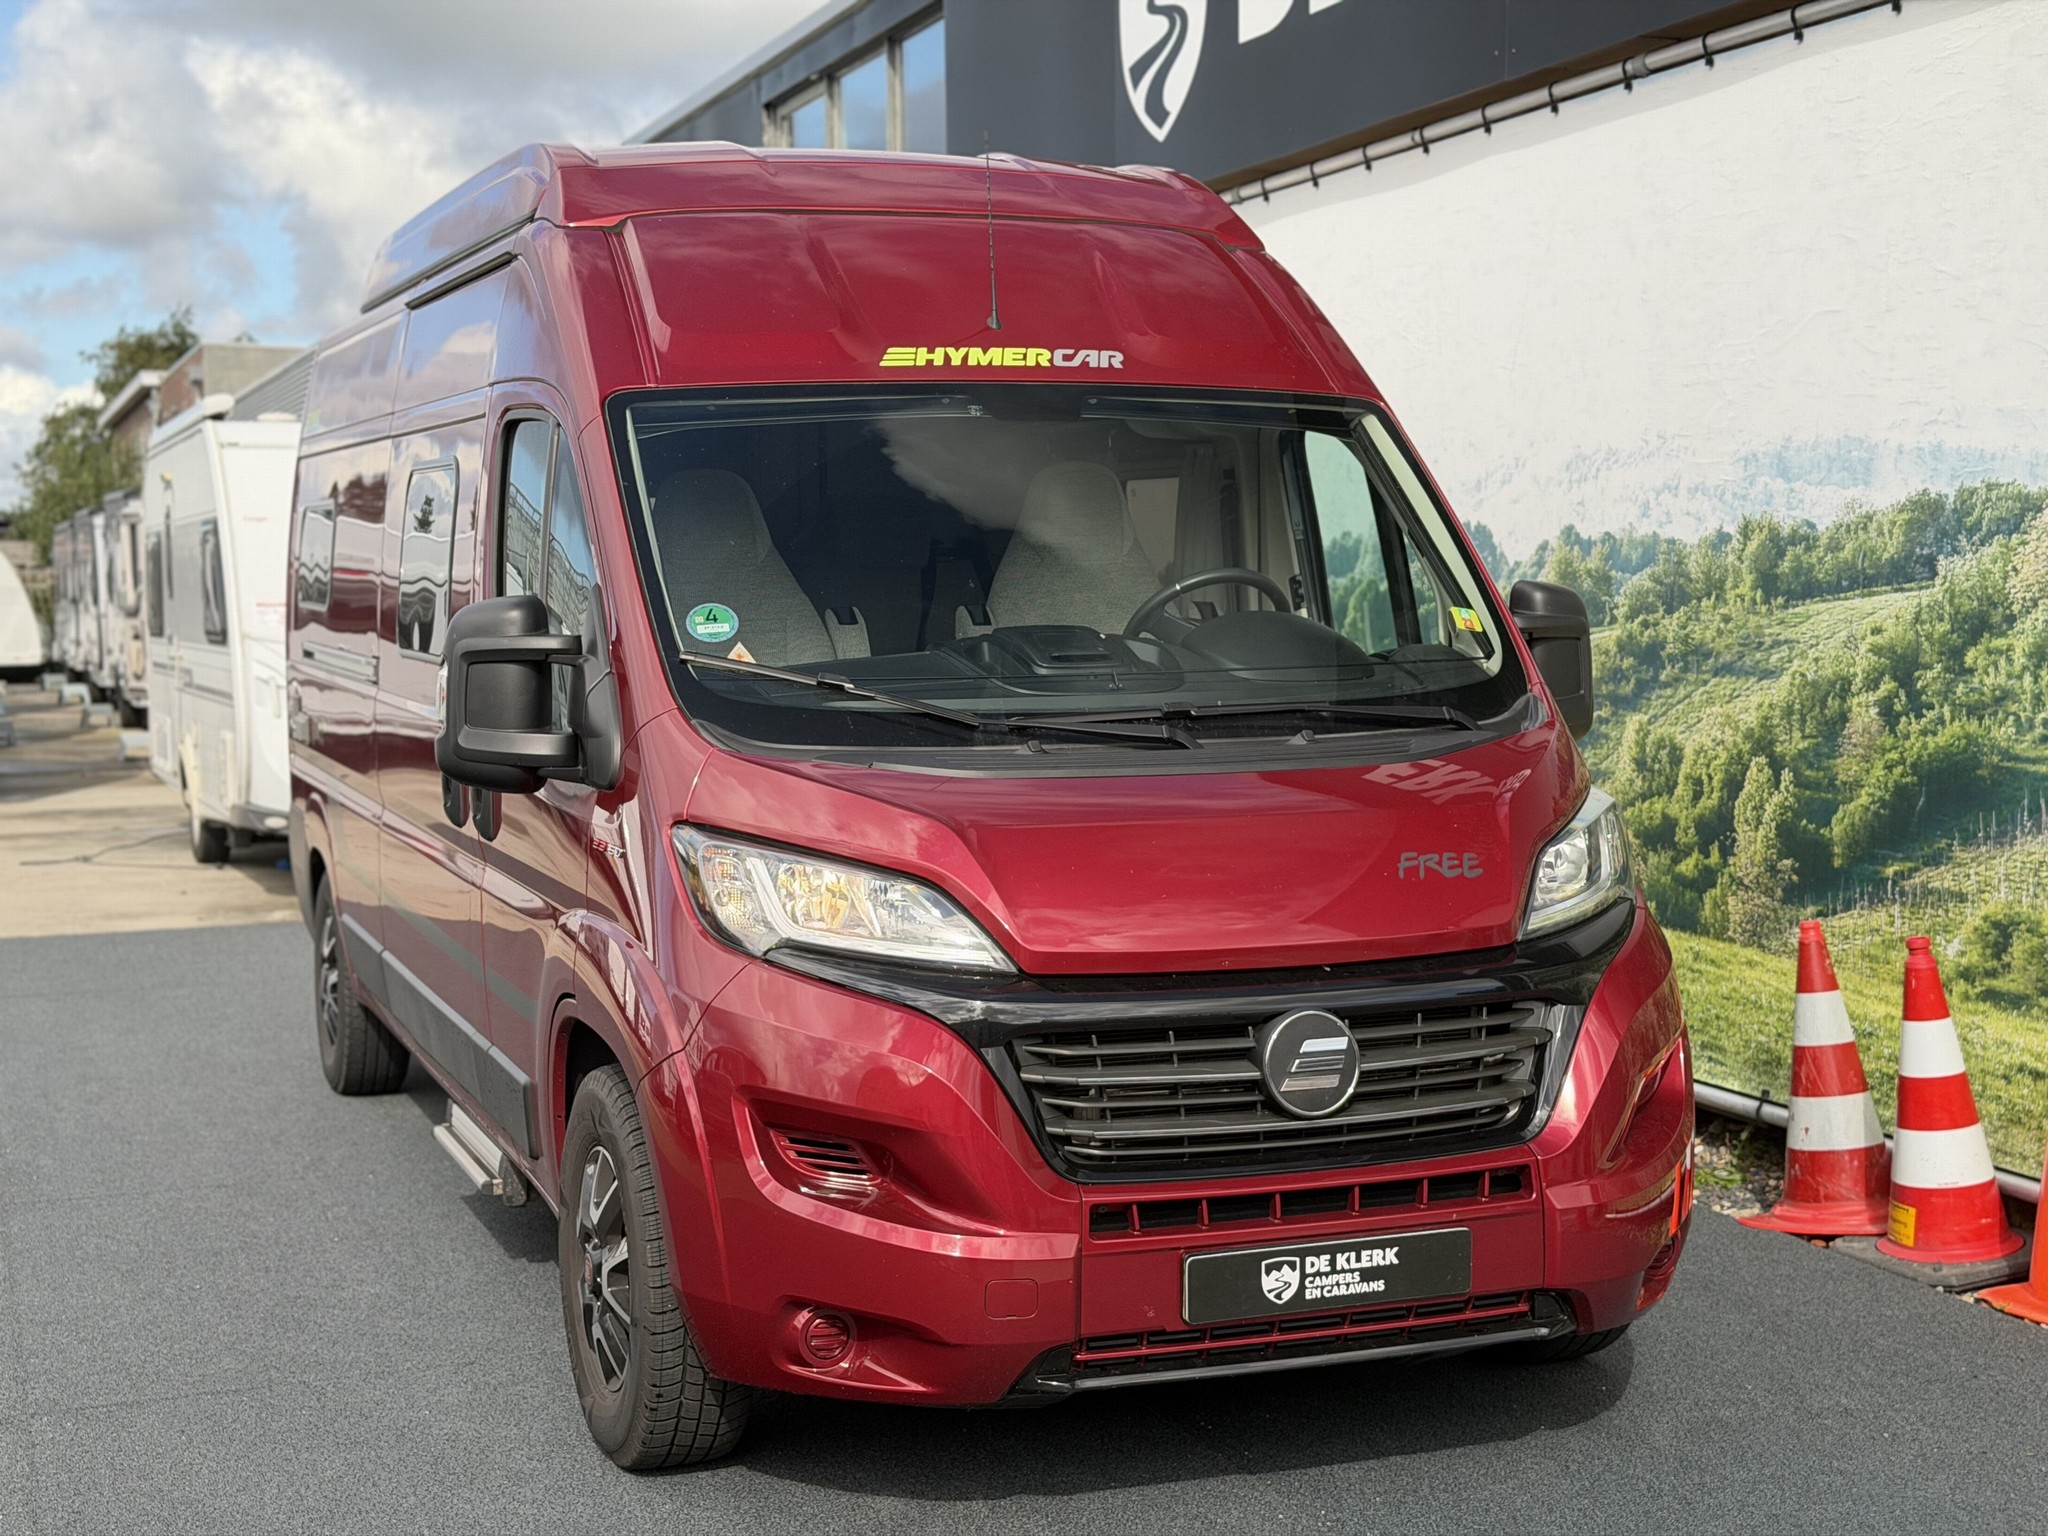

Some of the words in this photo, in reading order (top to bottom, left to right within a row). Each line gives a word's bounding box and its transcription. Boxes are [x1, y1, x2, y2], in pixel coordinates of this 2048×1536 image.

[914, 347, 1124, 369] HYMERCAR
[706, 608, 718, 623] 4
[1397, 851, 1484, 880] FREE
[1304, 1255, 1331, 1274] DE
[1335, 1246, 1400, 1271] KLERK
[1304, 1271, 1361, 1288] CAMPERS
[1304, 1287, 1321, 1300] EN
[1322, 1280, 1386, 1298] CARAVANS
